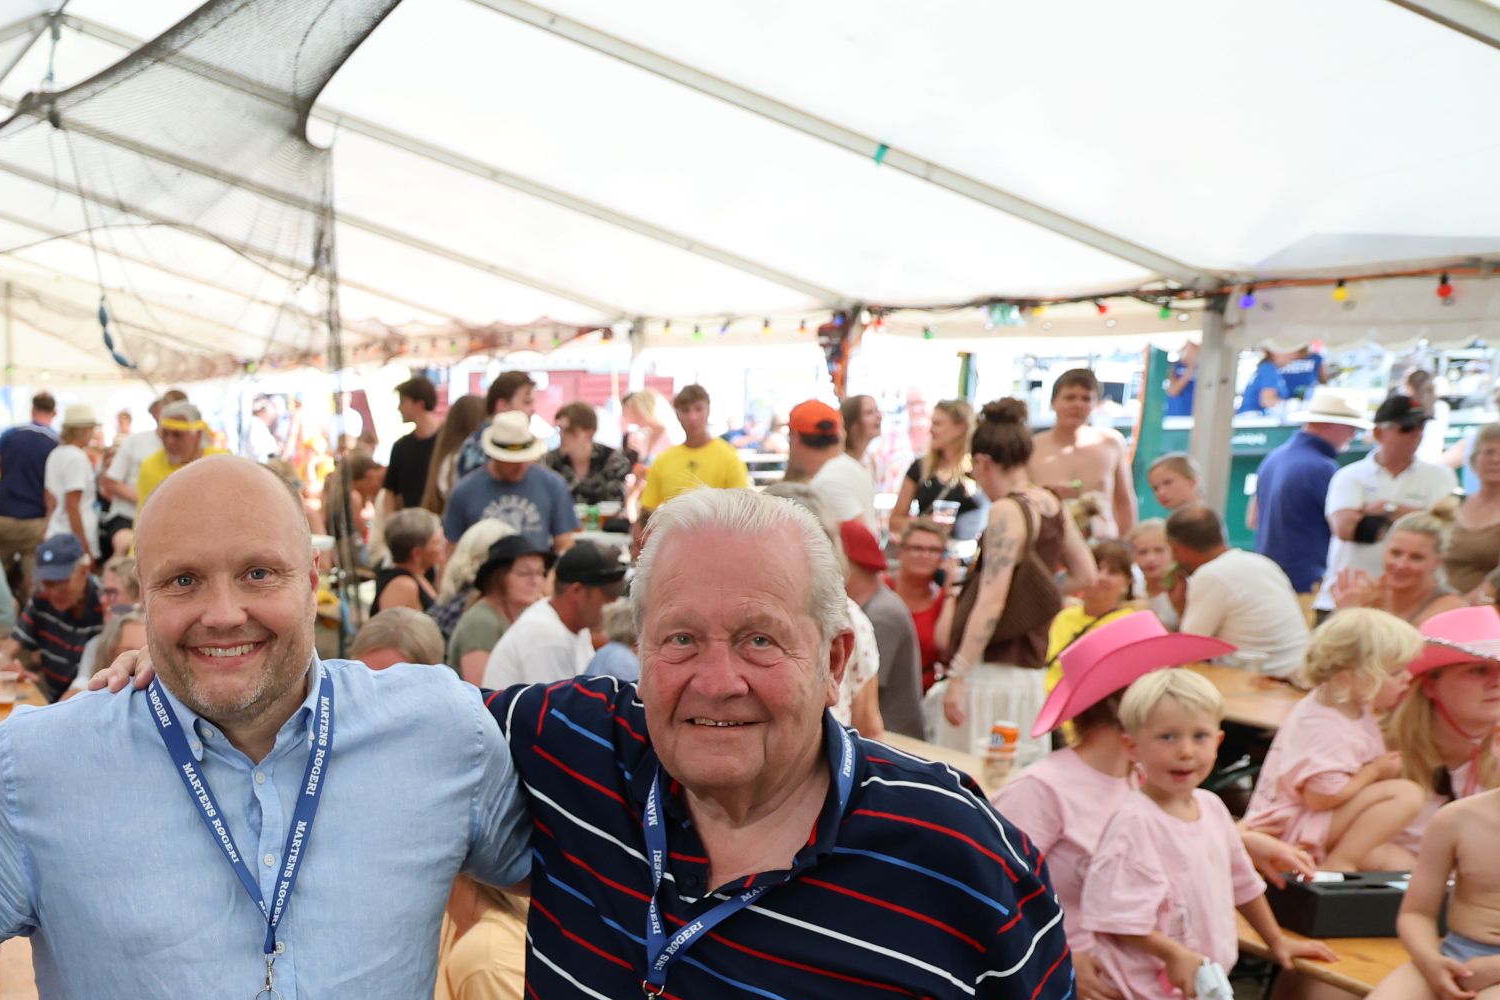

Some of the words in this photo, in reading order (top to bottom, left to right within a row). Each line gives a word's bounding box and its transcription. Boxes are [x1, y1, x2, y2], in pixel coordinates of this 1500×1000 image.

[317, 695, 331, 747] MARTENS
[305, 746, 326, 798] RØGERI
[182, 761, 217, 818] MARTENS
[211, 818, 240, 864] RØGERI
[283, 820, 308, 879] MARTENS
